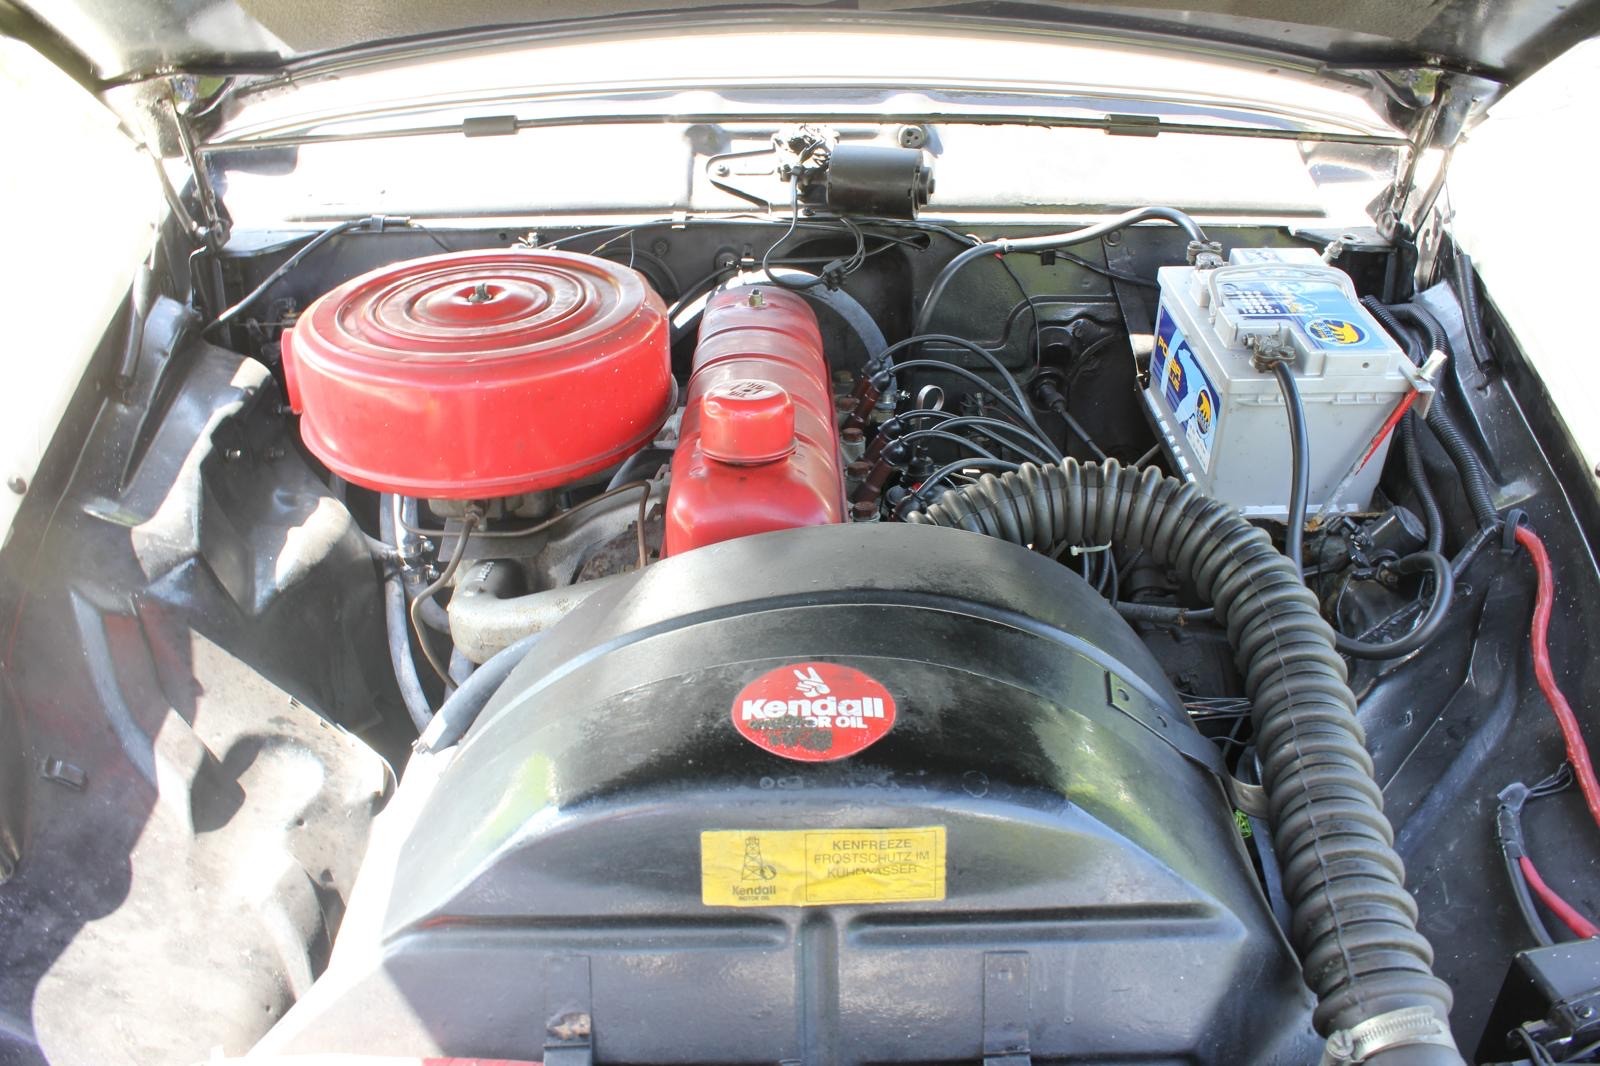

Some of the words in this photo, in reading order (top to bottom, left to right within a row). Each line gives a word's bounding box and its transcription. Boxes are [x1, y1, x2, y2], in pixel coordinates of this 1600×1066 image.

[742, 696, 884, 720] Kendall
[832, 838, 912, 851] KENFREEZE
[814, 851, 912, 865] FROSTSCHUTZ
[916, 850, 930, 861] IM
[732, 885, 776, 896] Kendall
